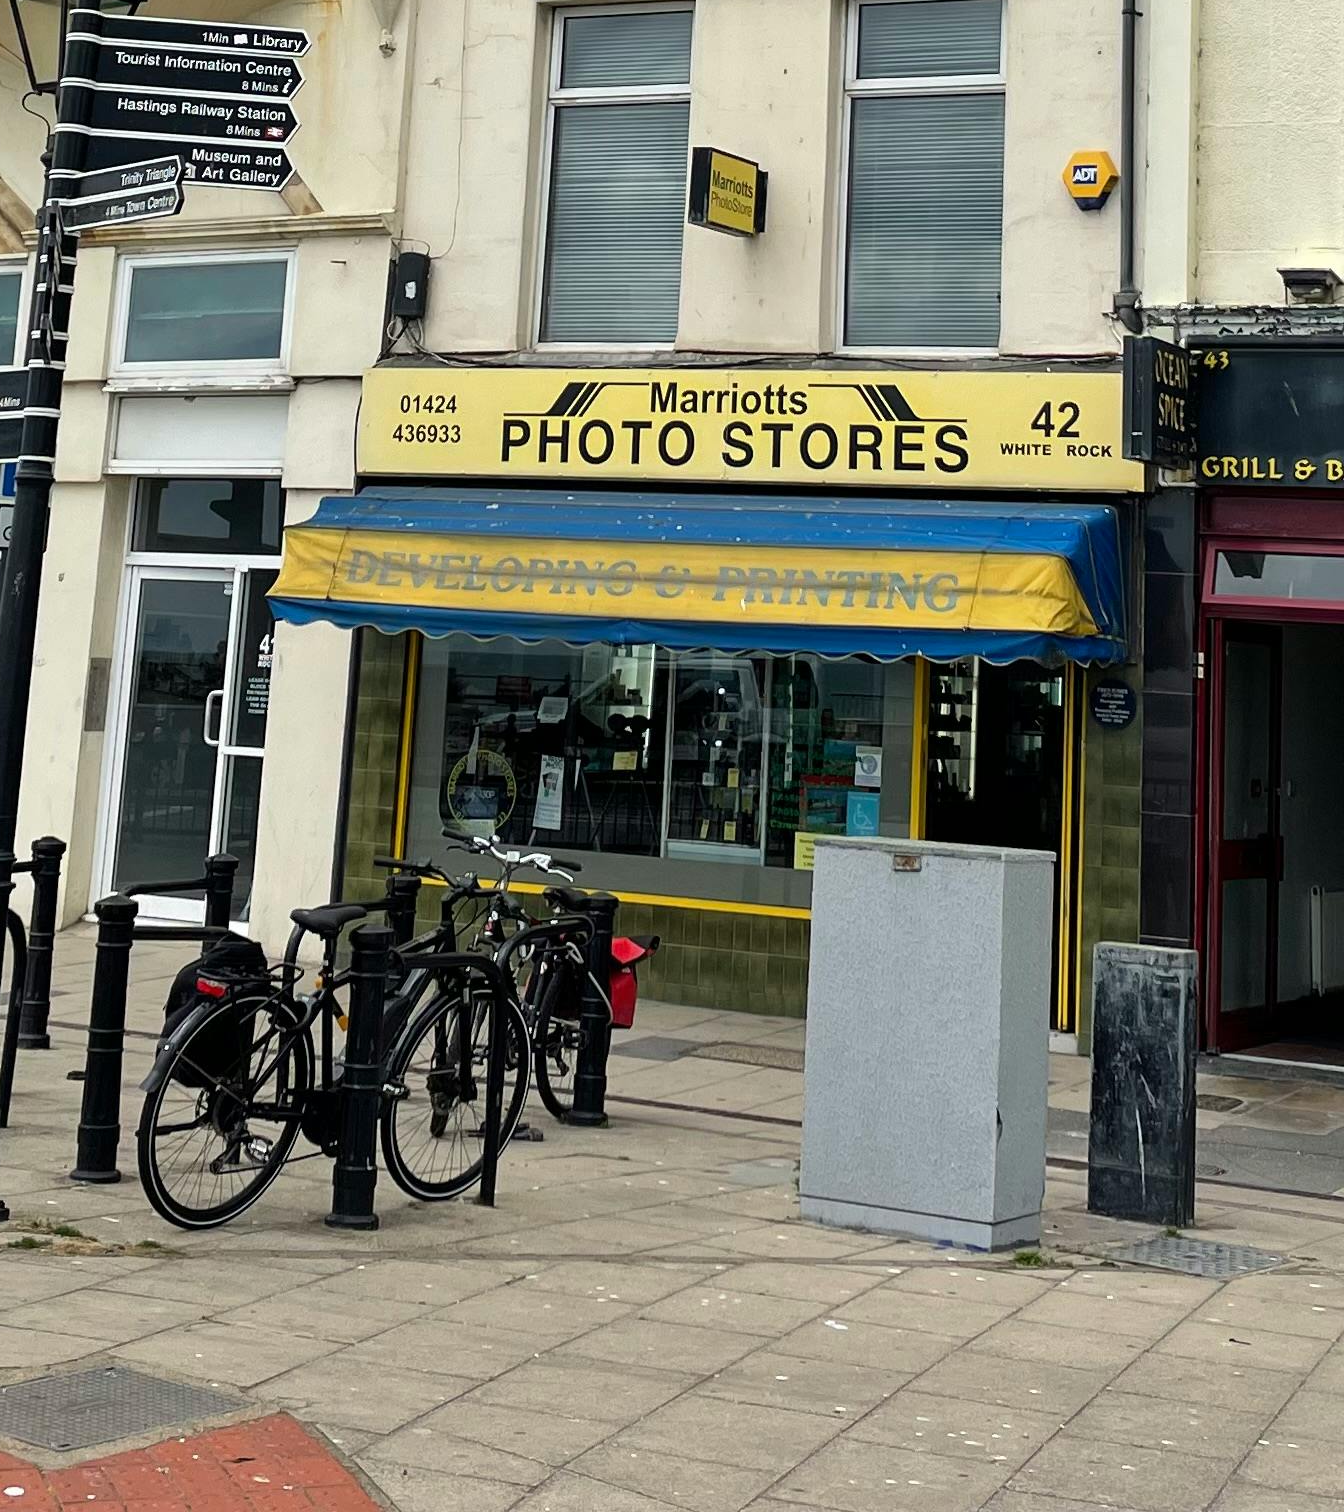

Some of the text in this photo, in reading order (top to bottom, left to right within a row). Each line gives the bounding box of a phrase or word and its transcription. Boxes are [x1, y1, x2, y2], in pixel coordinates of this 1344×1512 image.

[253, 34, 303, 53] Library
[115, 51, 292, 76] Tourist Information Centre
[242, 81, 279, 92] 8 Mins
[117, 98, 286, 121] Hastings Railway Station
[192, 149, 282, 166] Museum and
[121, 166, 176, 186] Trinity Triangle
[202, 166, 280, 186] Art Gallery
[712, 170, 754, 199] Marriotts
[1072, 167, 1098, 182] ADT
[126, 201, 146, 213] Town
[147, 195, 175, 210] Centre
[1155, 350, 1189, 389] OCEAN
[1204, 351, 1229, 370] 43
[399, 394, 457, 414] 01424
[650, 381, 809, 416] Marriotts
[1030, 401, 1081, 438] 42
[1158, 392, 1186, 432] SPICE
[392, 424, 461, 444] 436933
[500, 419, 969, 473] PHOTO STORES
[1000, 443, 1113, 458] WHITE ROCK
[1202, 456, 1284, 480] GRILL
[1294, 459, 1317, 480] &
[347, 548, 959, 613] DEVELOPING & PRINTING
